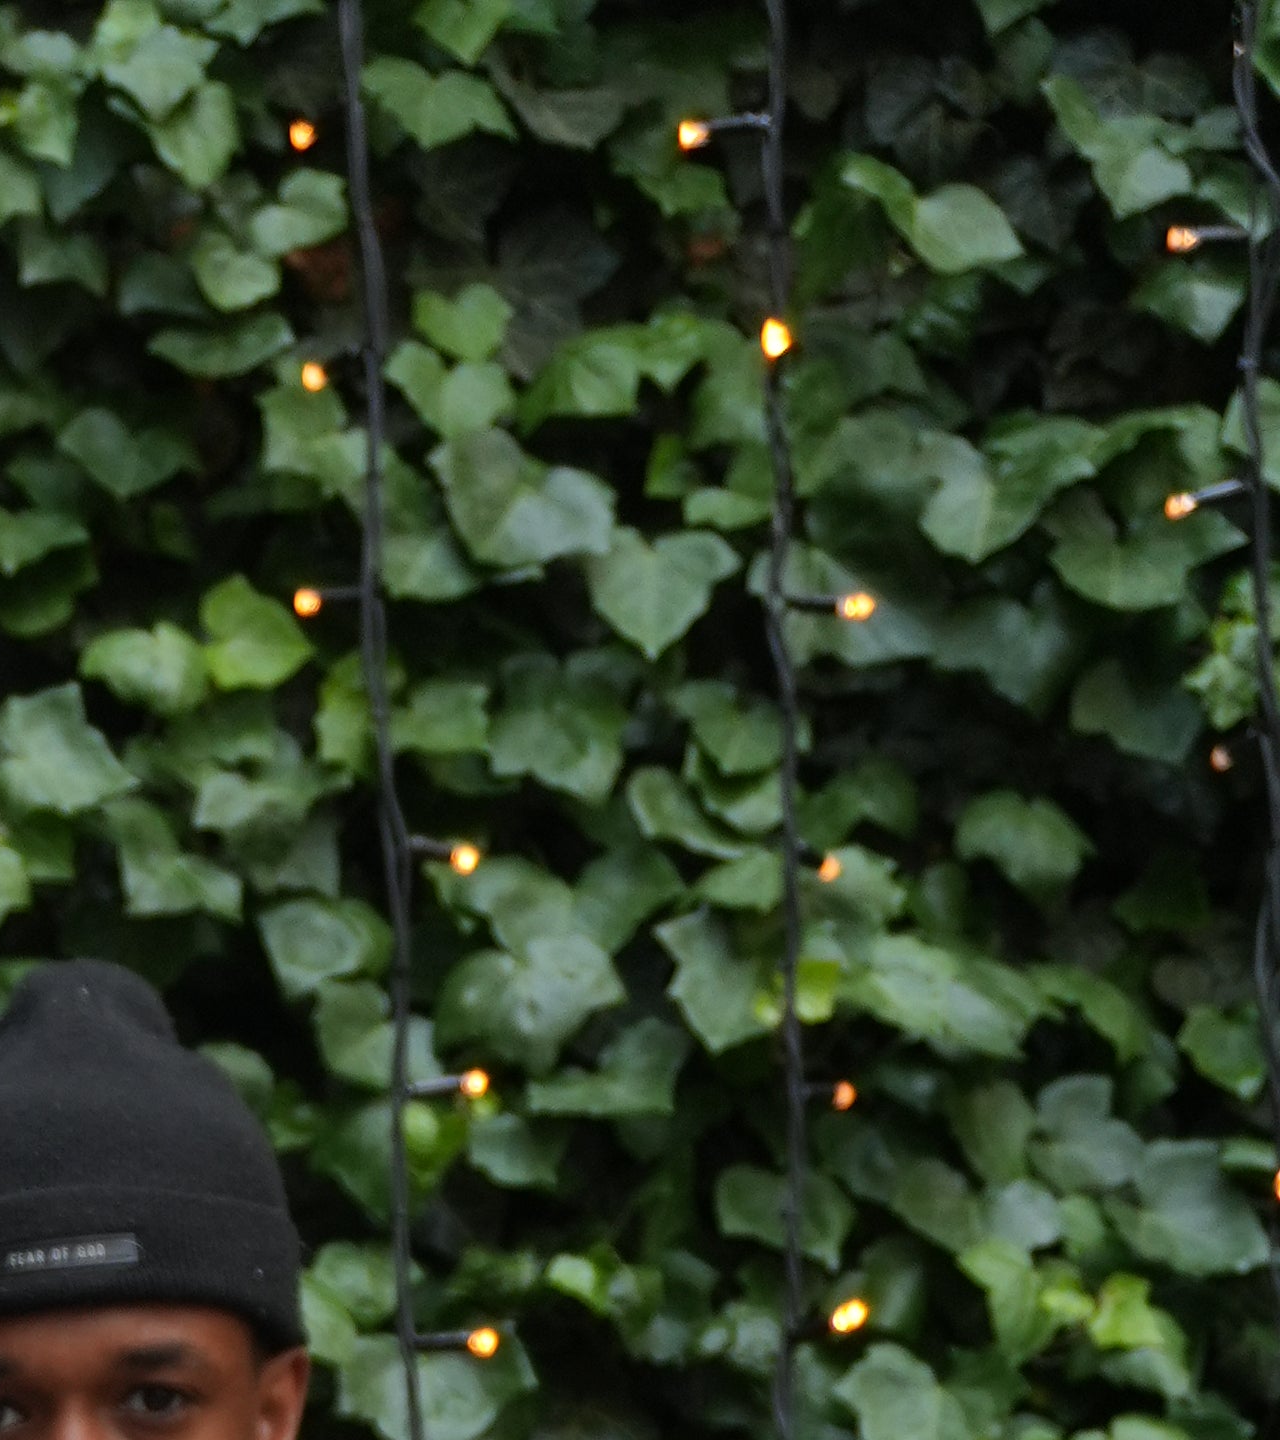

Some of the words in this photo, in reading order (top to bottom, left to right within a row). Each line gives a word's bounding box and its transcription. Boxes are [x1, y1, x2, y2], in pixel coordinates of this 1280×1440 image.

[8, 1248, 45, 1269] FEAR
[50, 1246, 70, 1262] OF
[76, 1243, 107, 1258] GOD
